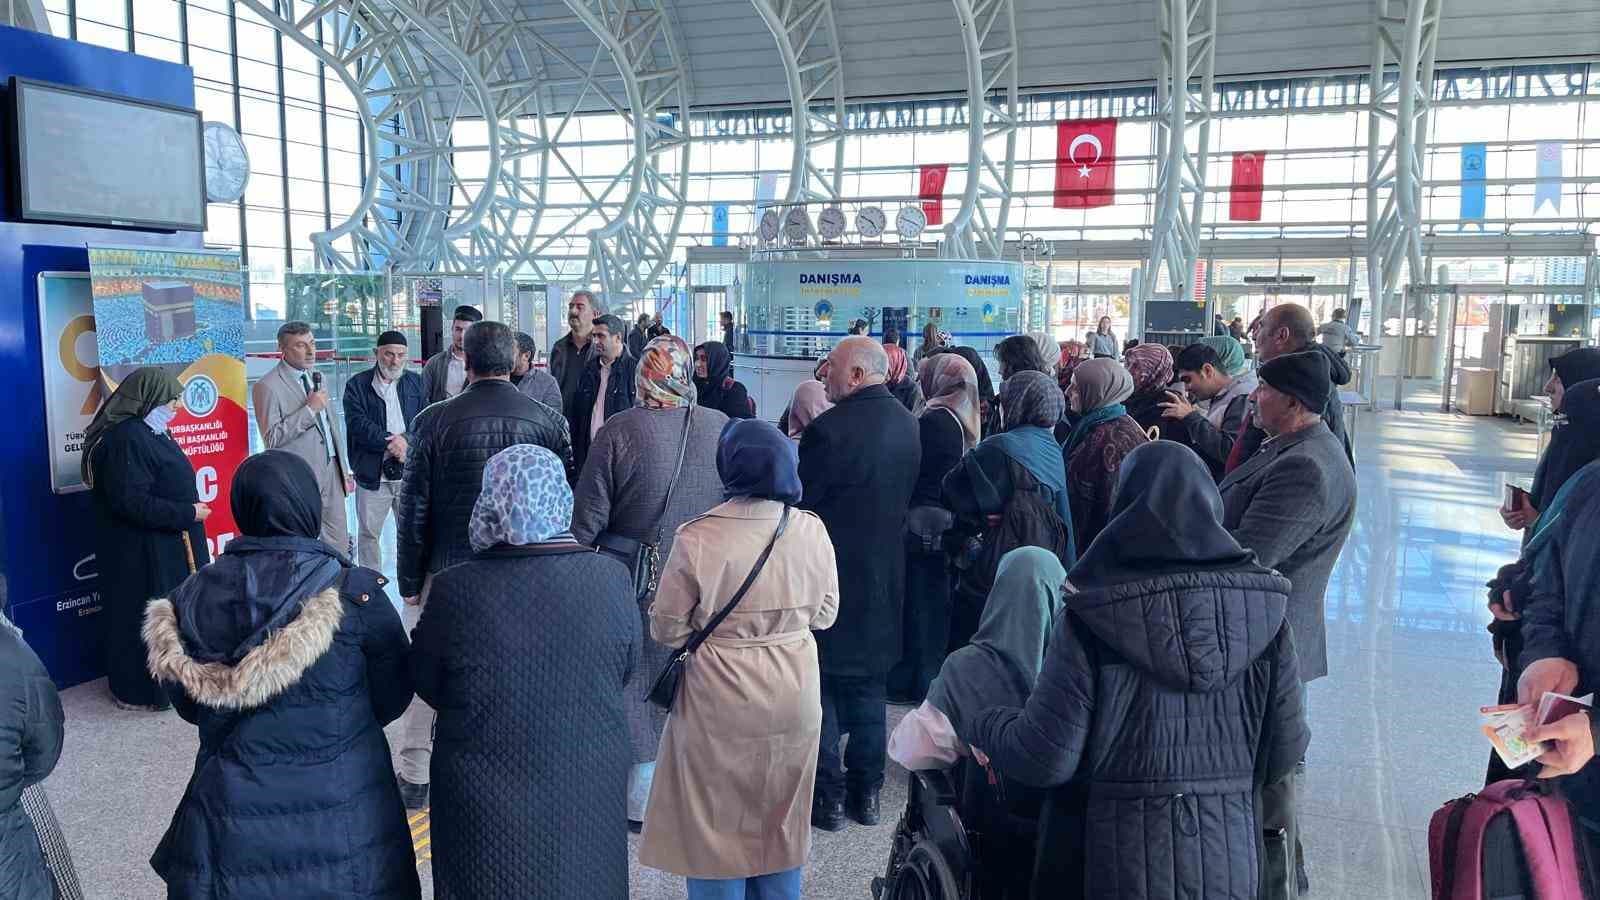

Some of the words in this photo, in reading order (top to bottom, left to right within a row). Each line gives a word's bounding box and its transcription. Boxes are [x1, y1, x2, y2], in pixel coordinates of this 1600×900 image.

[800, 273, 862, 286] DANIŞMA
[965, 274, 1010, 287] DANIŞMA
[169, 420, 222, 433] URBAŞKANLIĞI
[186, 431, 227, 444] BAŞKANLIĞI
[56, 595, 91, 612] Erzincan
